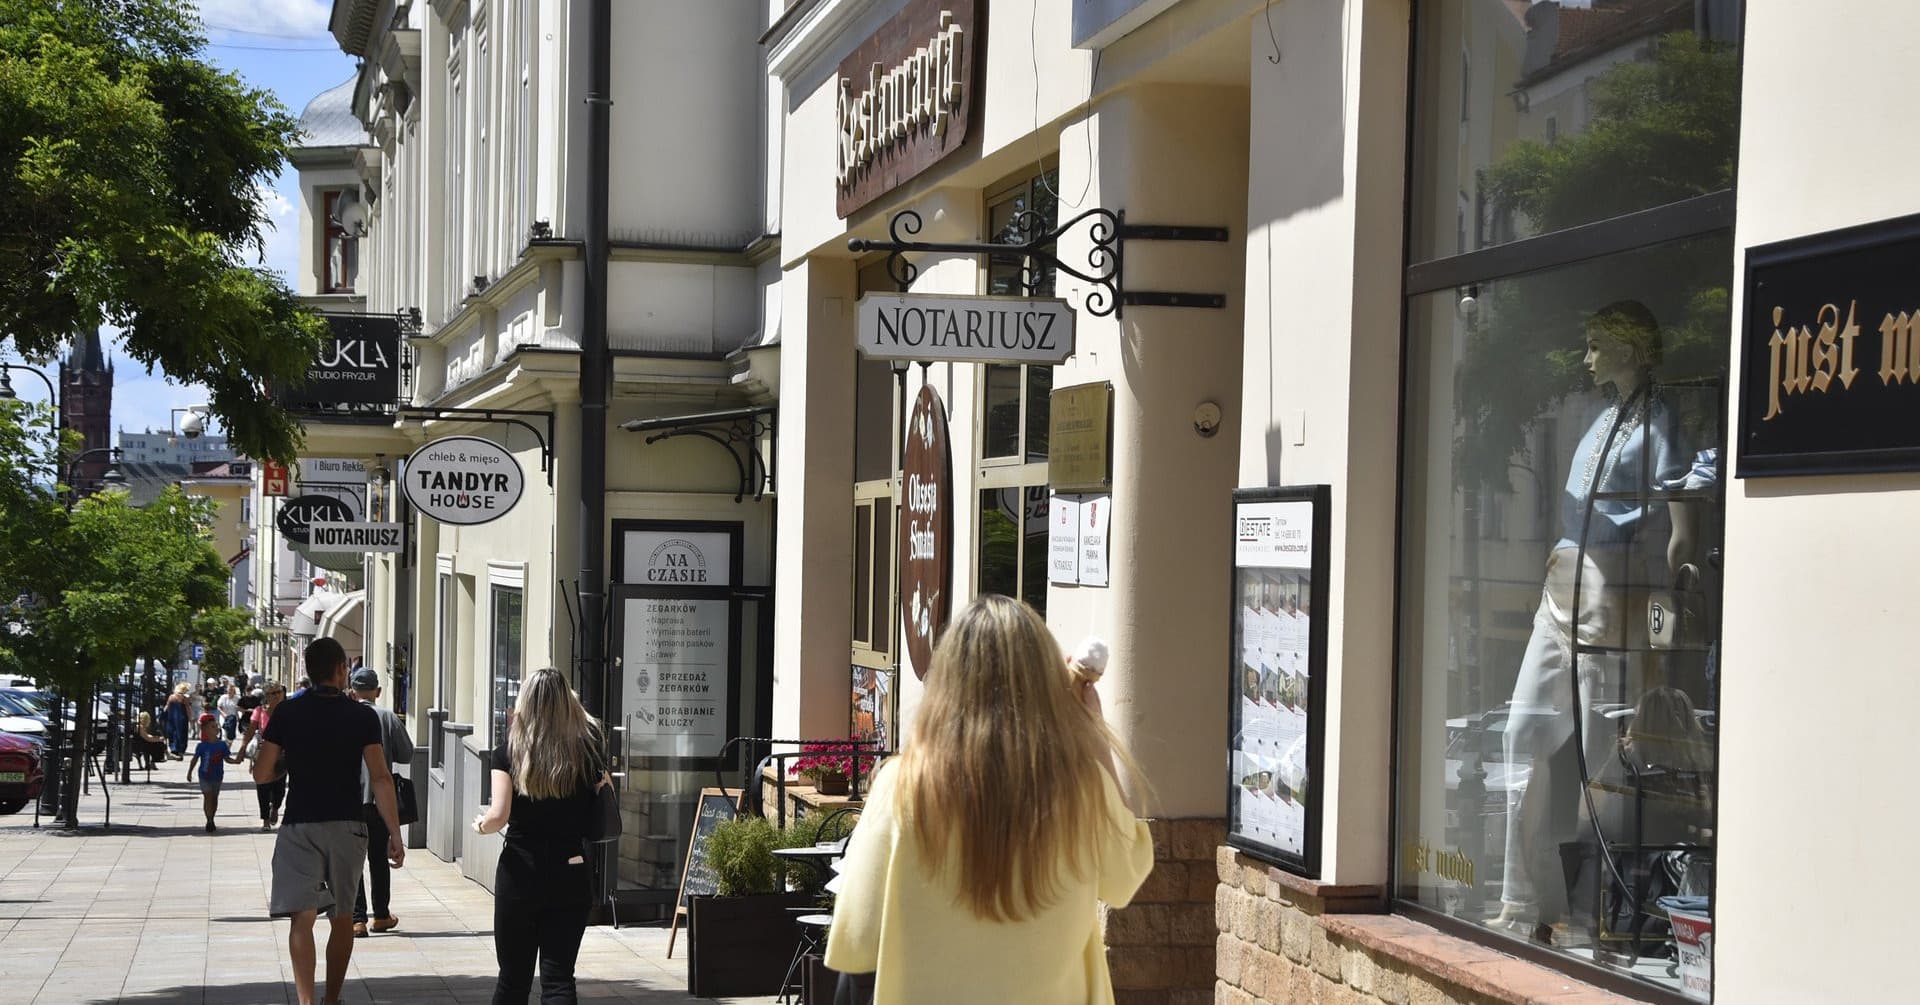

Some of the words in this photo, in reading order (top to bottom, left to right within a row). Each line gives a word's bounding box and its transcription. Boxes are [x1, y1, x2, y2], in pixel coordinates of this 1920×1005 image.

[875, 306, 1057, 350] NOTARIUSZ
[311, 339, 389, 368] UKLA
[1762, 299, 1861, 421] just
[308, 371, 340, 380] STUDIO
[342, 371, 376, 381] FRYZUR
[428, 451, 456, 462] chleb
[458, 453, 467, 463] &
[469, 453, 500, 465] mięso
[319, 461, 340, 471] Biuro
[417, 470, 509, 493] TANDYR
[430, 492, 496, 509] HOUSE
[314, 527, 400, 546] NOTARIUSZ
[665, 553, 689, 567] NA
[647, 568, 707, 582] CZASIE
[646, 603, 697, 613] ZEGARKÓW
[659, 682, 710, 693] ZEGARKÓW
[658, 706, 716, 716] DORABIANIE
[658, 718, 695, 727] KLUCZY
